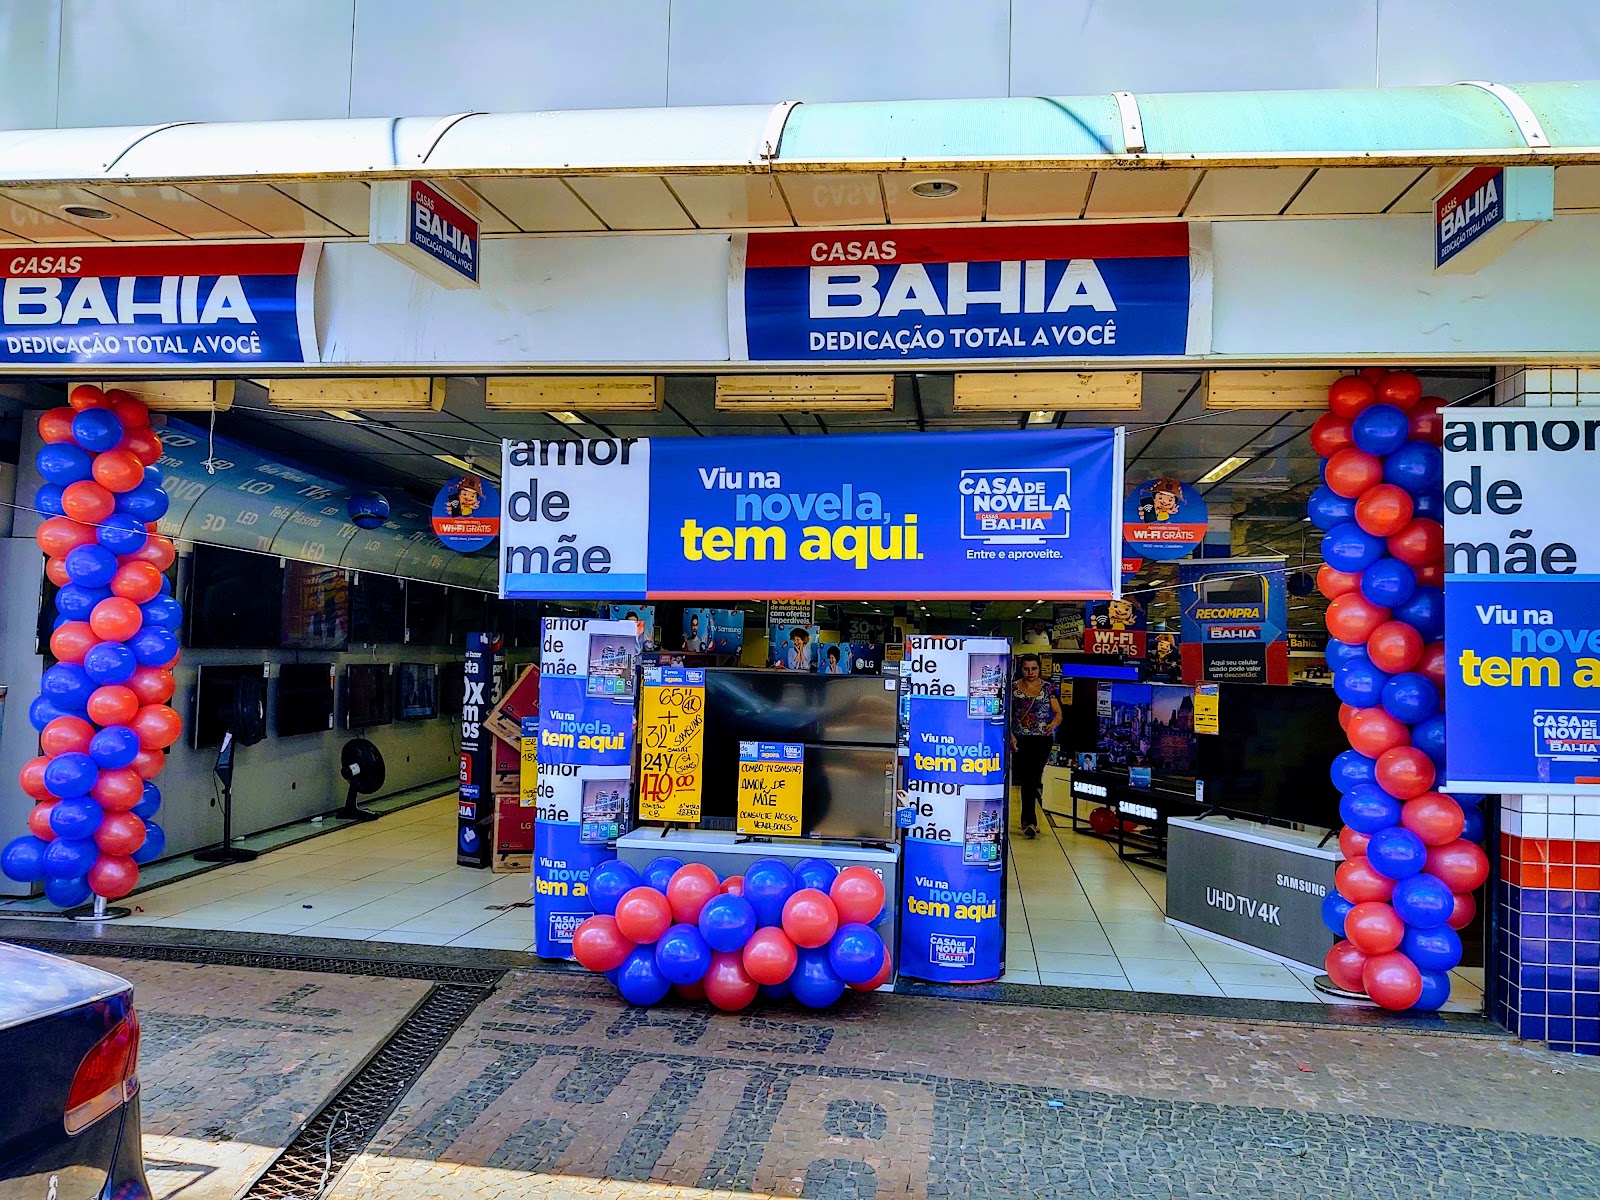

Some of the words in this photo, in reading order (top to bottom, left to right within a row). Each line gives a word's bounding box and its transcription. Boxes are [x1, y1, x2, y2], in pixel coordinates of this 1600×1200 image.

[416, 191, 434, 210] CASAS
[1441, 197, 1457, 217] CASAS
[1441, 178, 1499, 244] BAHIA
[416, 202, 472, 260] BAHIA
[415, 232, 443, 253] DEDICAÇÃO
[810, 240, 898, 262] CASAS
[1441, 230, 1466, 258] DEDICAÇÃO
[9, 256, 83, 275] CASAS
[808, 258, 1118, 319] BAHIA
[2, 275, 258, 325] BAHIA
[6, 330, 120, 358] DEDICAÇÃO
[123, 336, 189, 355] TOTAL
[193, 336, 206, 354] A
[205, 330, 262, 355] VOCÊ
[809, 325, 945, 356] DEDICAÇÃO
[949, 326, 1027, 348] TOTAL
[1031, 326, 1049, 347] A
[1049, 319, 1118, 346] VOCÊ
[509, 439, 641, 467] amor
[160, 475, 208, 502] DVD
[237, 478, 276, 496] LCD
[698, 467, 744, 491] Viu
[746, 469, 782, 490] na
[958, 477, 1025, 495] CASA
[1024, 482, 1046, 494] DE
[1444, 464, 1524, 516] de
[508, 477, 571, 523] de
[735, 483, 893, 528] novela,
[973, 493, 1072, 513] NOVELA
[200, 512, 227, 533] 3D
[235, 509, 260, 526] LED
[269, 505, 291, 520] Tela
[289, 510, 323, 528] Plasma
[981, 518, 1046, 531] BAHIA
[681, 516, 789, 562] tem
[799, 513, 926, 571] aqui.
[1133, 530, 1161, 539] WI-FI
[1161, 529, 1194, 540] GRÁTIS
[301, 540, 327, 562] LED
[506, 533, 613, 575] mãe
[966, 549, 997, 560] Entre
[998, 551, 1006, 560] e
[1007, 548, 1064, 561] aproveite.
[1444, 528, 1578, 575] mãe
[1195, 607, 1260, 619] RECOMPRA
[1475, 604, 1519, 626] Viu
[1522, 608, 1554, 626] na
[545, 618, 589, 631] amor
[717, 626, 742, 636] Samsung
[1210, 629, 1257, 639] BAHIA
[543, 635, 564, 653] de
[911, 638, 968, 651] amor
[1093, 630, 1134, 645] WI-FI
[540, 658, 577, 675] mãe
[911, 654, 938, 674] de
[1228, 665, 1245, 673] pode
[1458, 649, 1562, 688] tem
[910, 679, 956, 697] mãe
[550, 710, 564, 720] Viu
[564, 712, 575, 721] na
[1532, 714, 1582, 728] CASA
[1581, 719, 1598, 728] DE
[560, 720, 615, 737] novela,
[541, 728, 575, 748] tem
[577, 732, 627, 754] aqui.
[920, 733, 939, 744] Viu
[940, 735, 955, 744] na
[1549, 743, 1598, 753] BAHIA
[935, 742, 994, 758] novela,
[537, 763, 582, 777] amor
[914, 752, 957, 772] tem
[961, 753, 1001, 776] aqui.
[537, 779, 555, 798] de
[908, 778, 965, 796] amor
[1073, 780, 1108, 798] SAMSUNG
[535, 804, 570, 822] mãe
[909, 797, 934, 817] de
[1119, 800, 1159, 820] SAMSUNG
[520, 822, 531, 830] LG
[539, 856, 555, 868] Viu
[554, 860, 567, 869] na
[536, 875, 568, 897] tem
[915, 876, 934, 888] Viu
[934, 879, 949, 890] na
[1276, 873, 1326, 898] SAMSUNG
[929, 888, 990, 906] novela,
[908, 896, 949, 919] tem
[954, 899, 998, 923] aqui.
[549, 915, 576, 924] CASA
[930, 936, 957, 947] CASA
[935, 945, 976, 955] NOVELA
[938, 953, 966, 963] BAHIA
